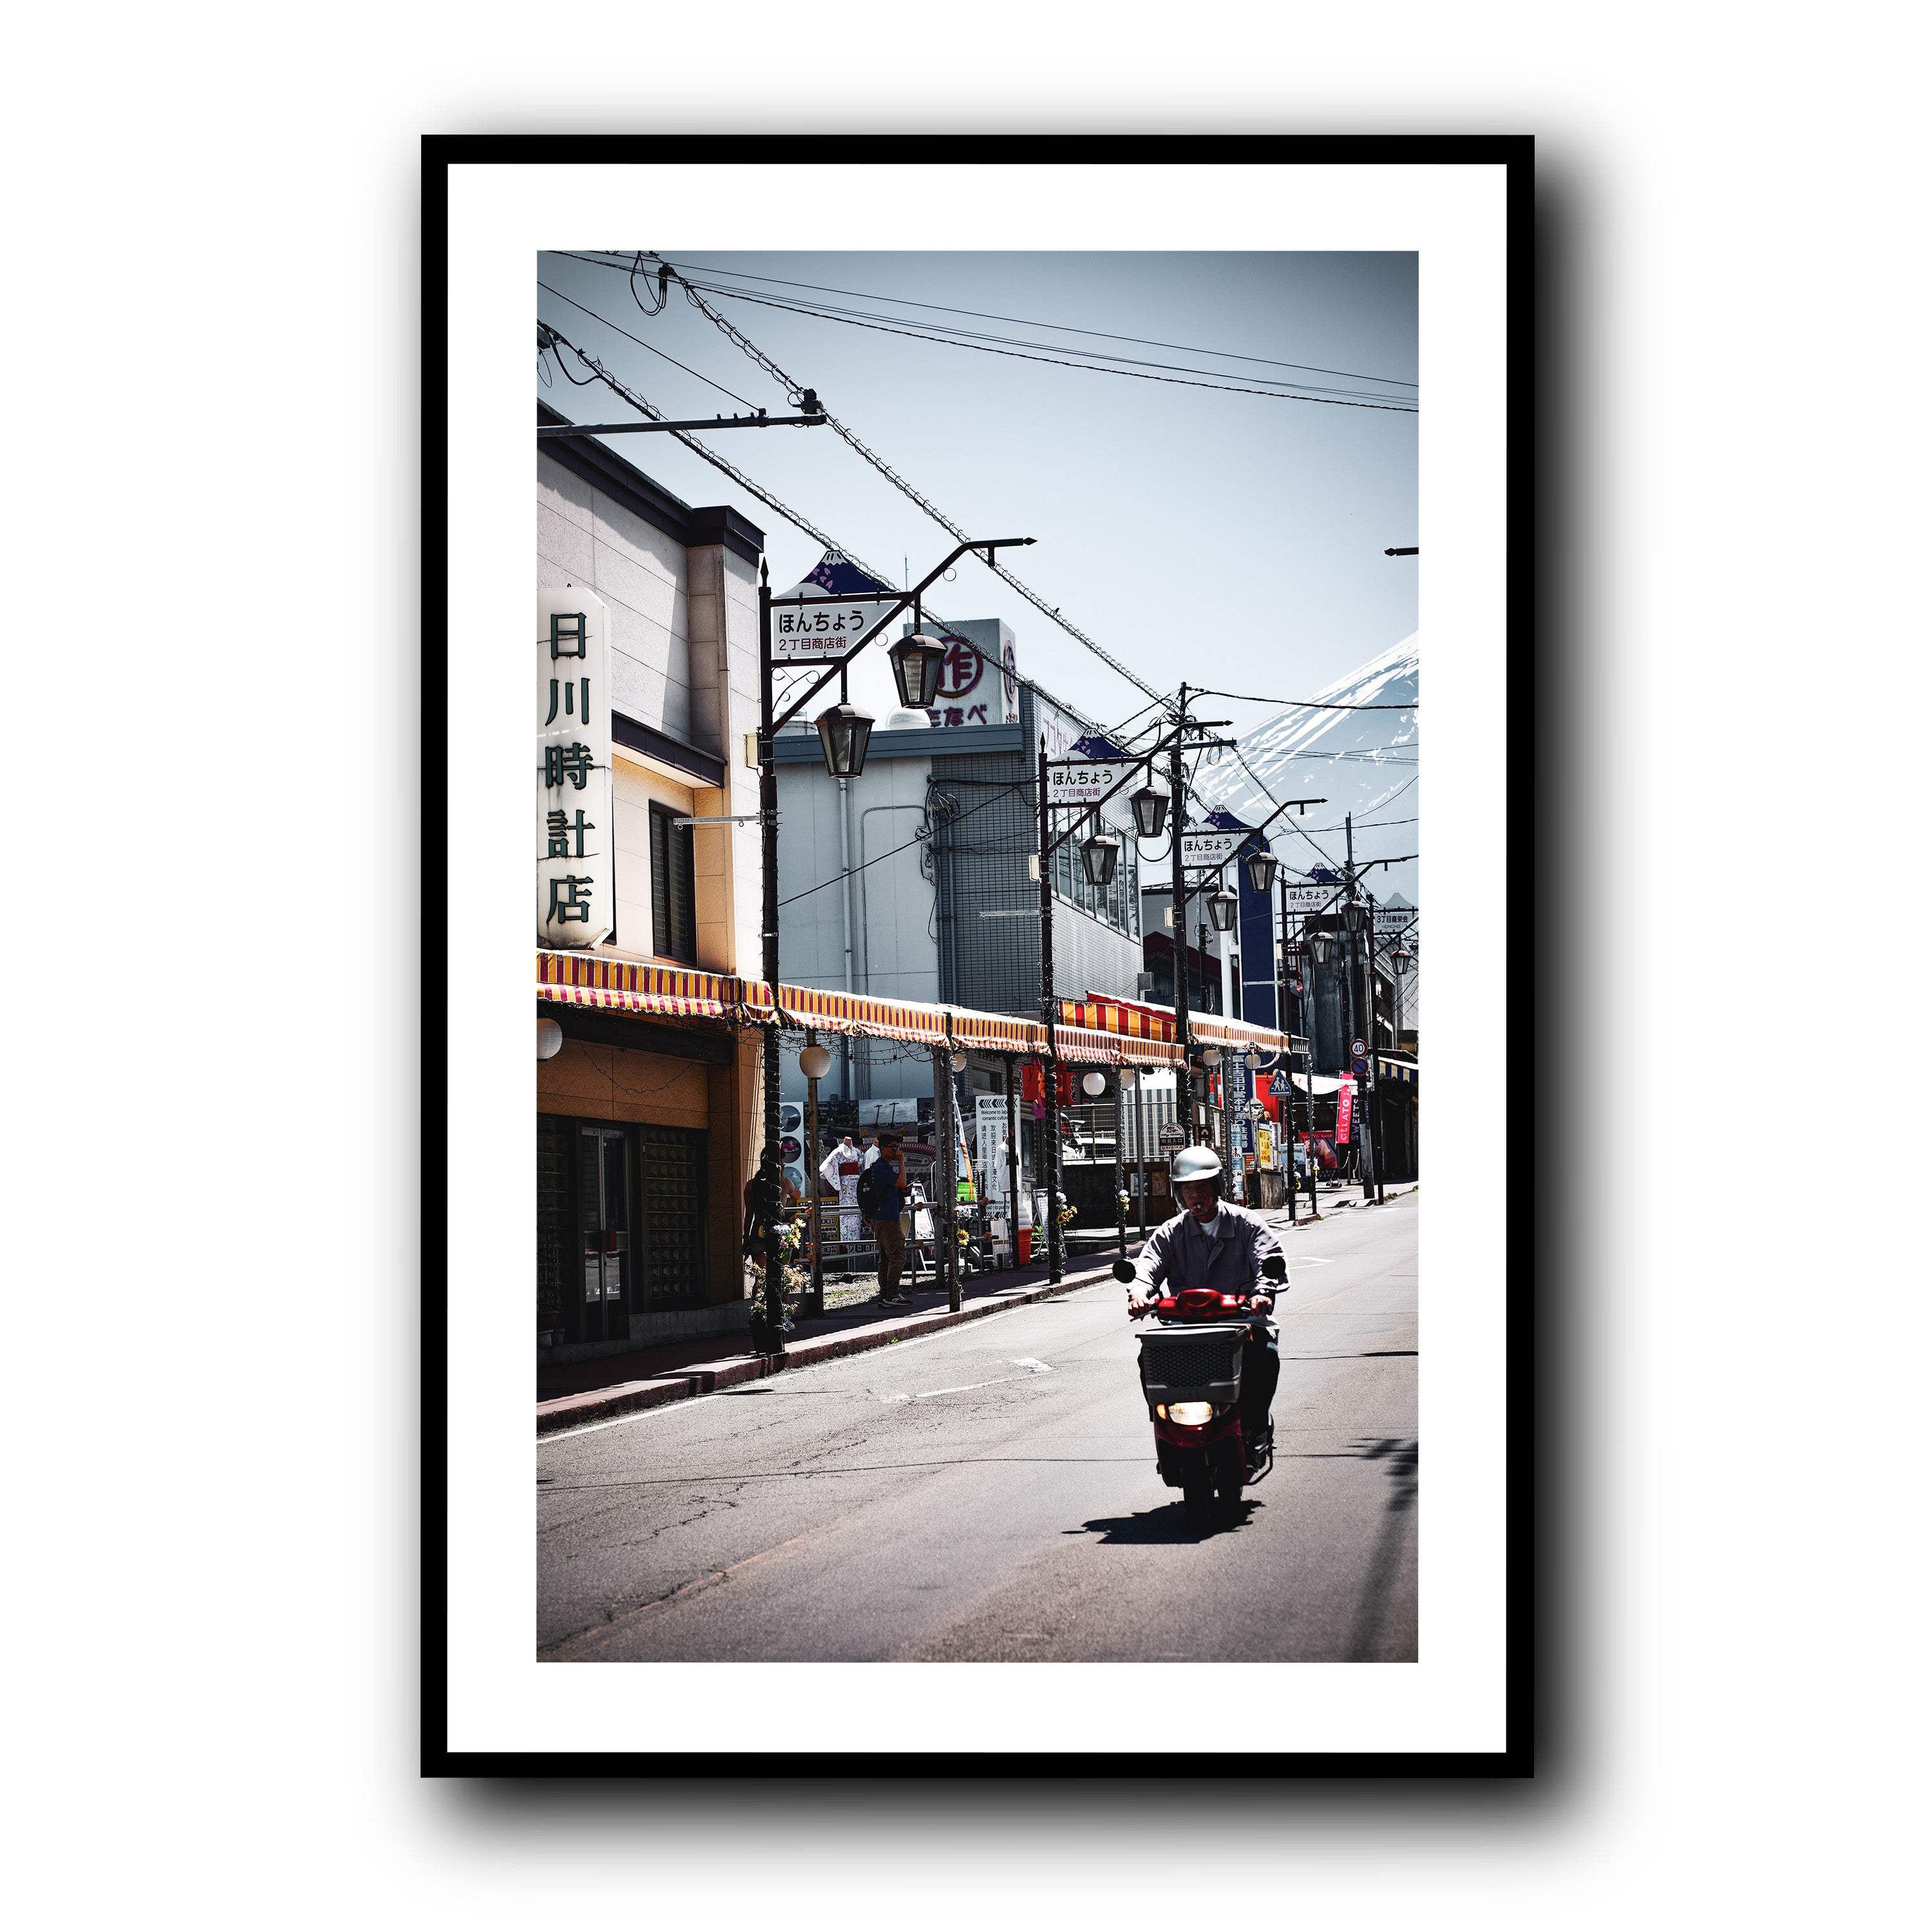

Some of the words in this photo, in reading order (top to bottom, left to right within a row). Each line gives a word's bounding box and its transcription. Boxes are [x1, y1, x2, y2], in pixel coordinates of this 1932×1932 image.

[779, 610, 864, 633] ほんちょう
[779, 636, 847, 651] 2丁目商店街
[545, 612, 595, 925] 日川時計店
[1053, 770, 1113, 786] ほんちょう
[1053, 788, 1101, 798] 2丁目商店街
[1184, 838, 1232, 852] ほんちょう
[1184, 853, 1223, 862] 2丁目商店街
[1289, 889, 1329, 900] ほんちょう
[1354, 1044, 1363, 1052] 40
[1341, 1099, 1350, 1141] GELATO
[1351, 1098, 1360, 1141] SWEETS
